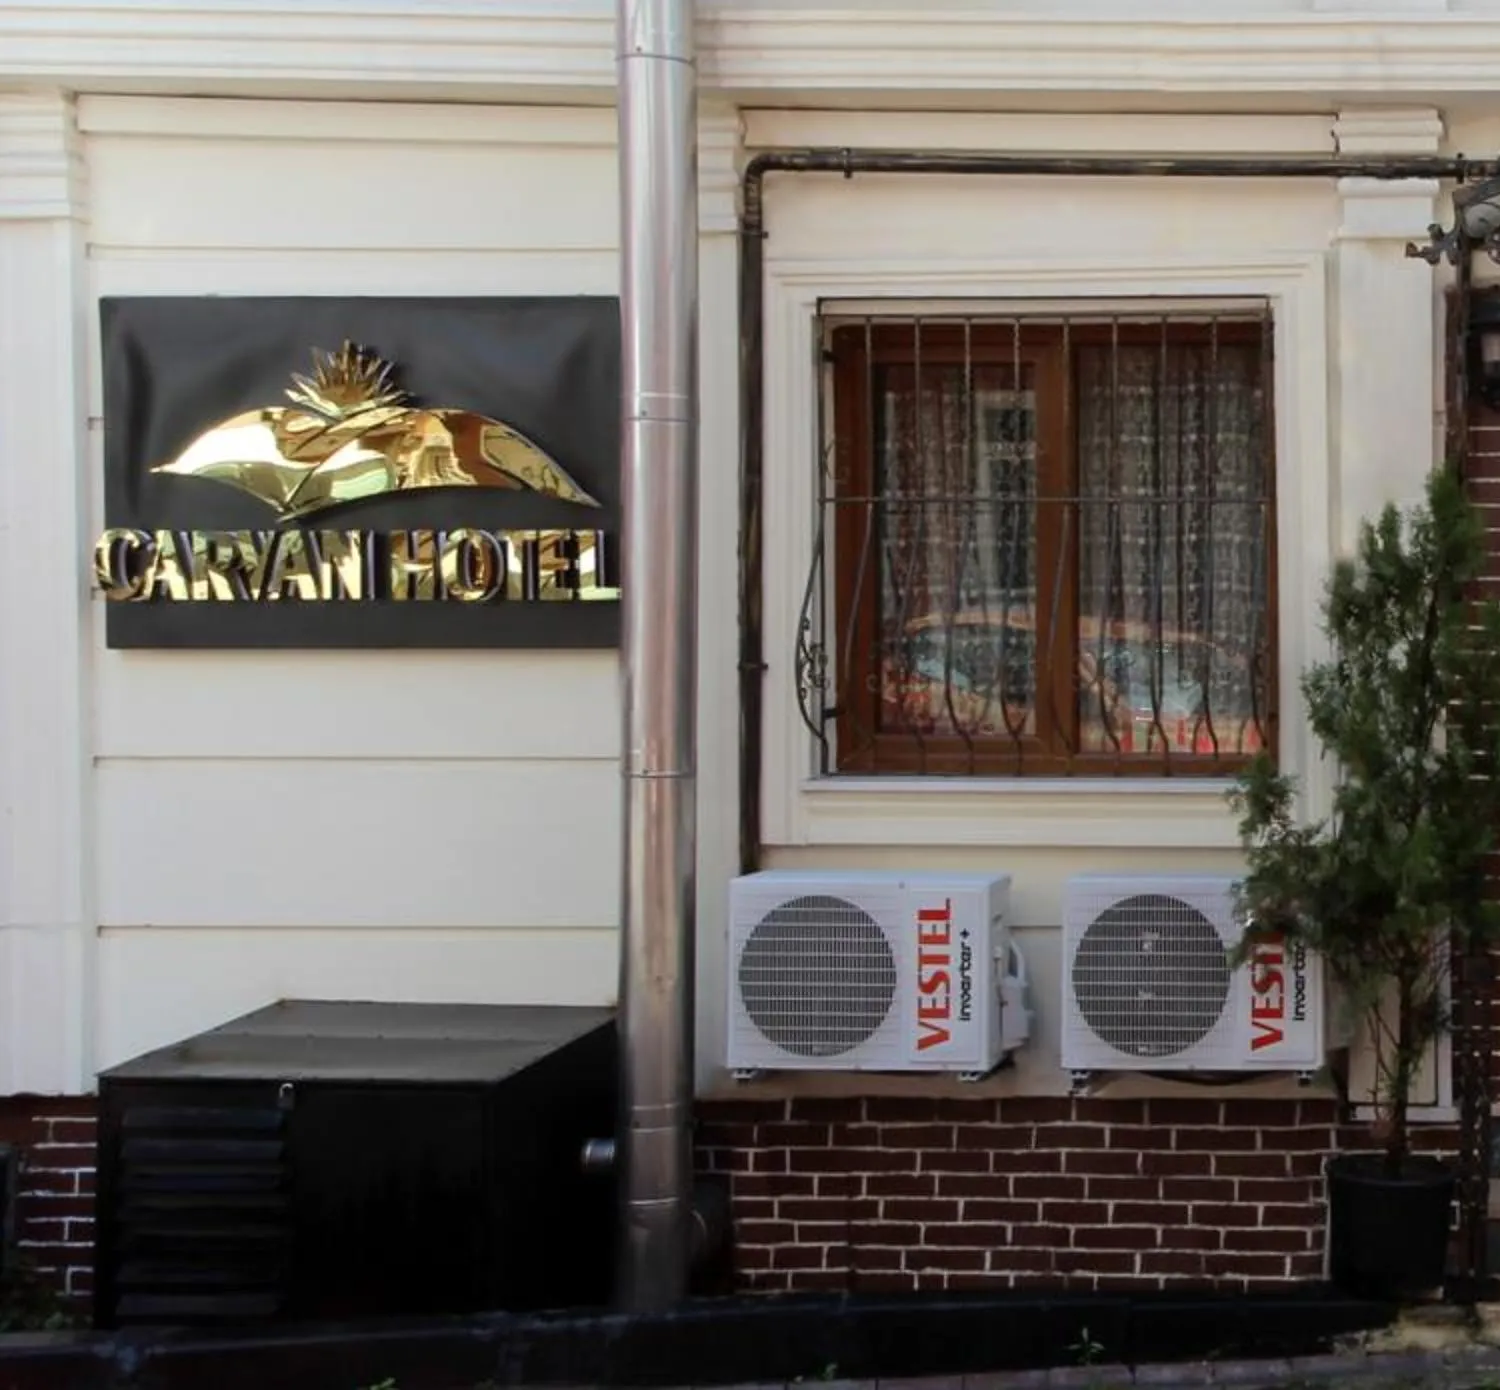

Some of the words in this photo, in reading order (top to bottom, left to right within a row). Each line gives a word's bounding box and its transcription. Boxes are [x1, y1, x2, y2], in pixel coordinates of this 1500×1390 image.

[95, 529, 364, 601] CARVAN
[390, 529, 621, 601] HOTEL
[916, 898, 951, 1051] VESTEL
[1251, 929, 1285, 1051] VEST
